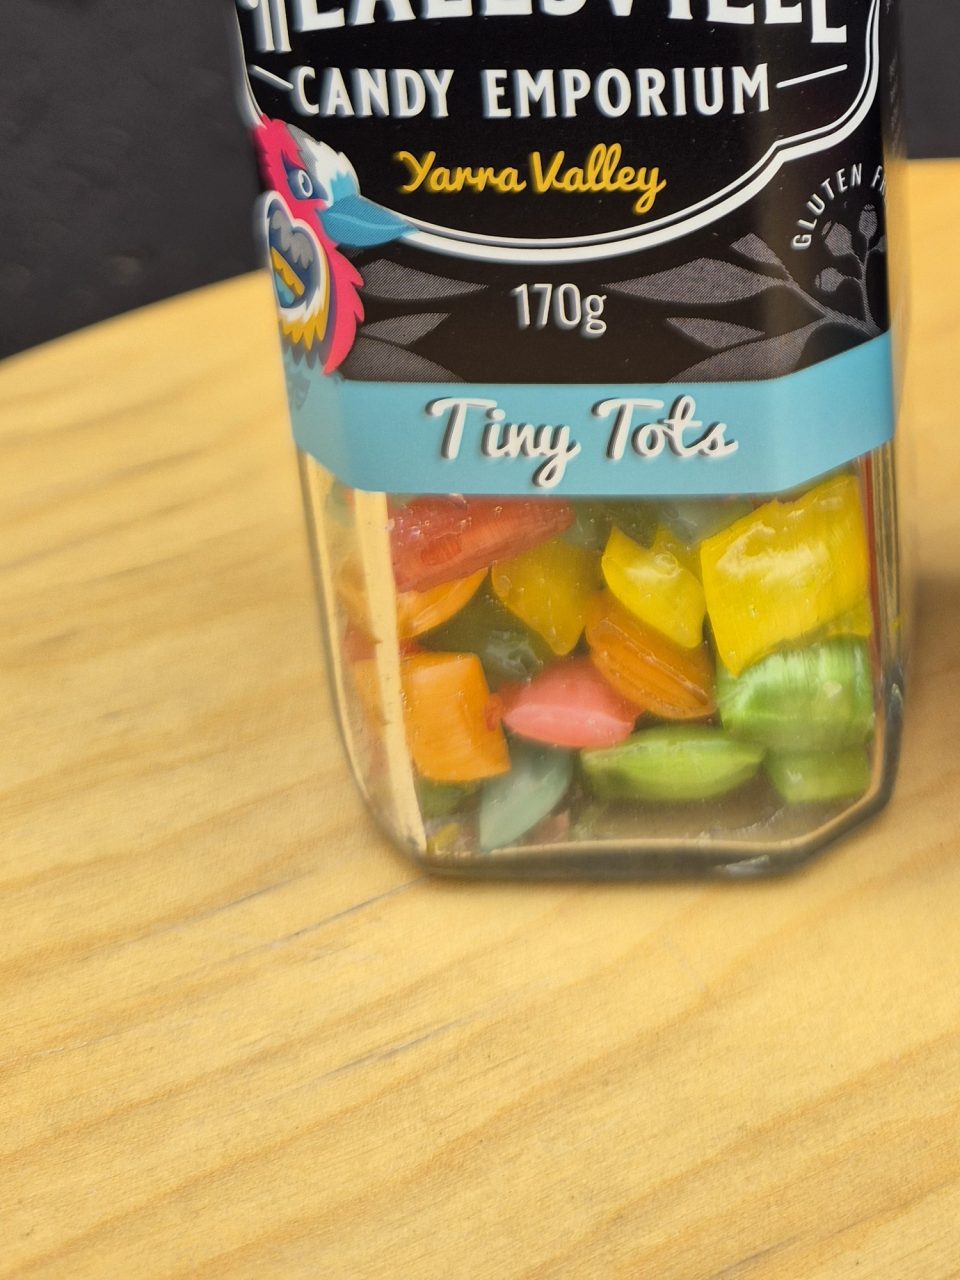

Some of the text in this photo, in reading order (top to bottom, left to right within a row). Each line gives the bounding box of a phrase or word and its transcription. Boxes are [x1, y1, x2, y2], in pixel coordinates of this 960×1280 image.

[294, 63, 770, 118] CANDY EMPORIUM
[398, 143, 668, 215] Yarra Valley
[791, 162, 863, 250] GLUTEN
[512, 282, 608, 336] 170g
[423, 394, 739, 489] Tiny Tots
